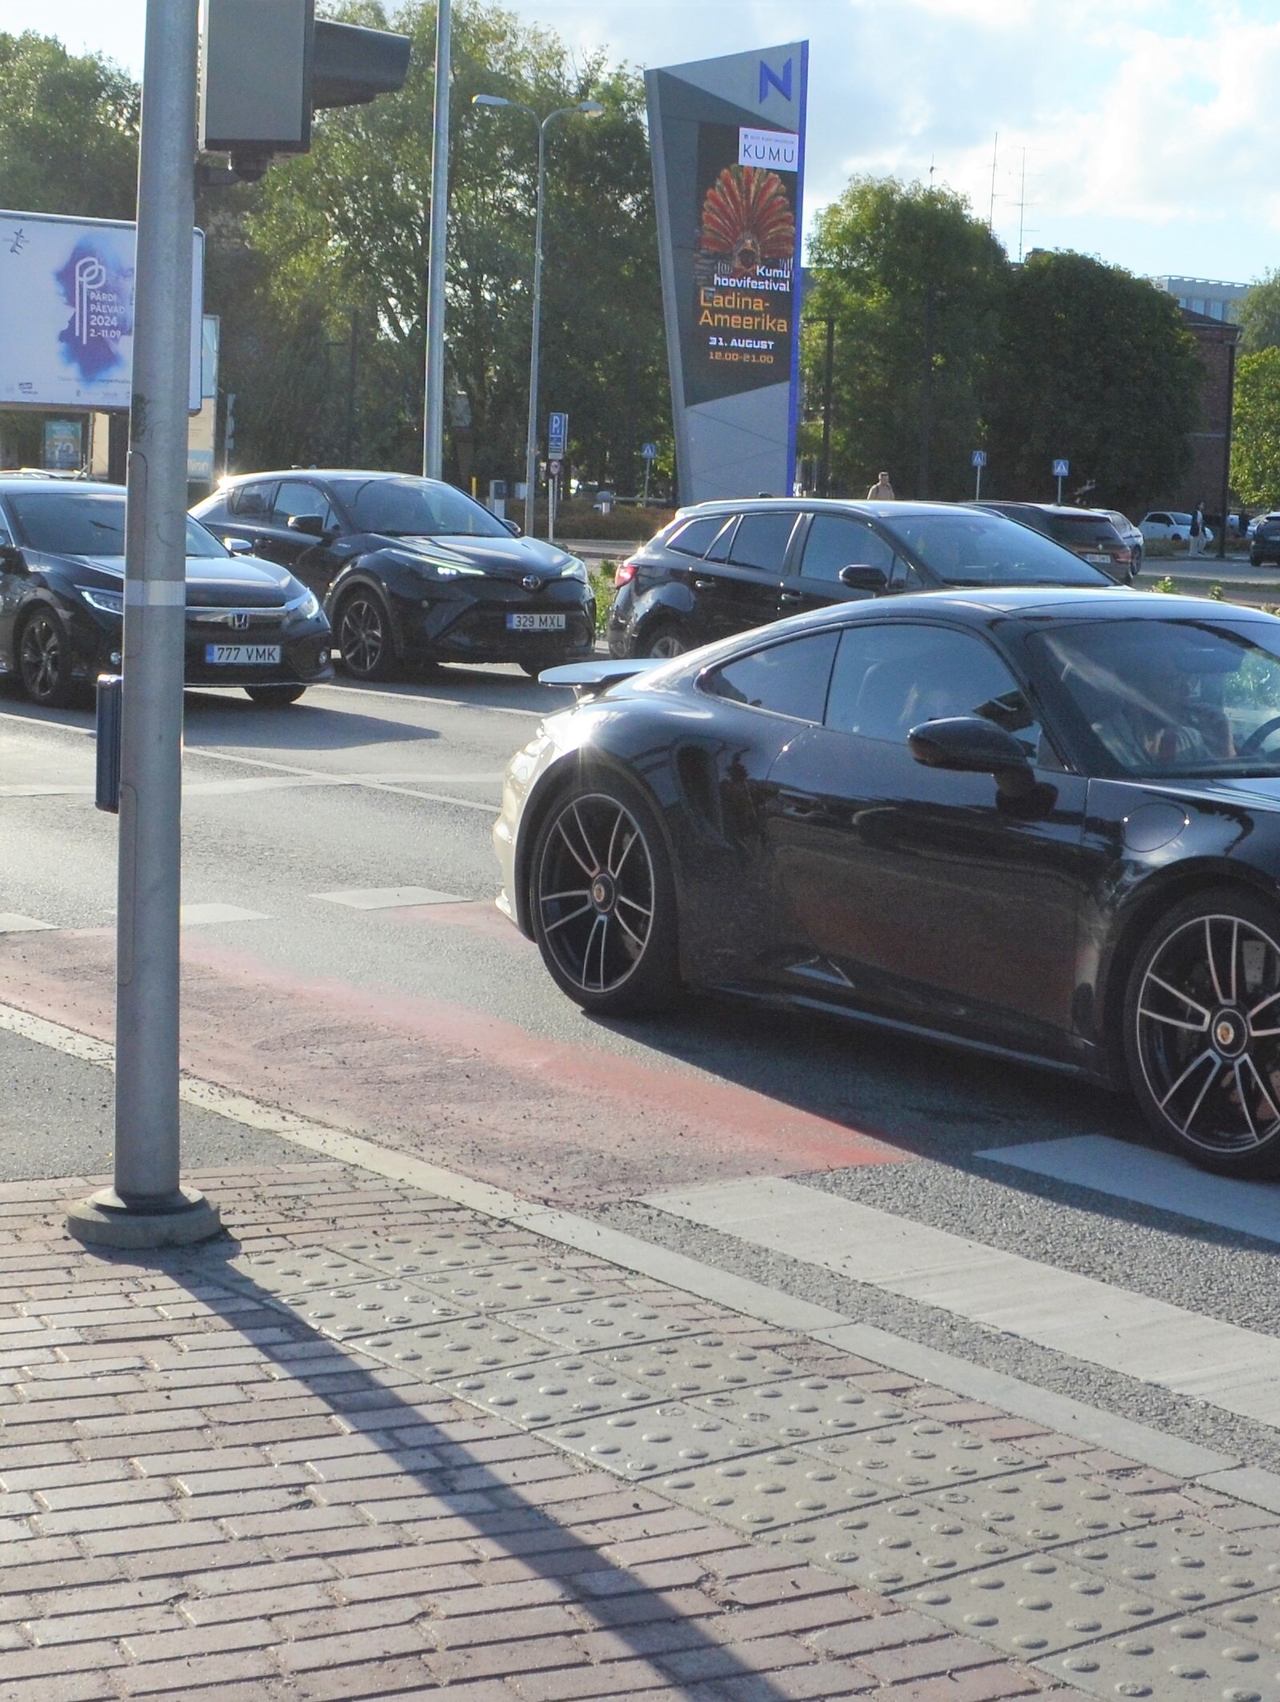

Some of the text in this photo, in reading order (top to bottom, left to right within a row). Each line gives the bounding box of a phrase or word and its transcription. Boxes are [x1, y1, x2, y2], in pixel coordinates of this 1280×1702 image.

[743, 143, 794, 163] KUMU
[756, 265, 790, 279] Kumu
[713, 273, 790, 292] hoovifestival
[700, 287, 770, 311] Ladina-
[90, 315, 118, 327] 2024
[699, 309, 788, 333] Ameerika
[709, 336, 775, 350] 31. AUGUST
[515, 615, 562, 628] 329 MXL
[217, 647, 276, 661] 777 VMK
